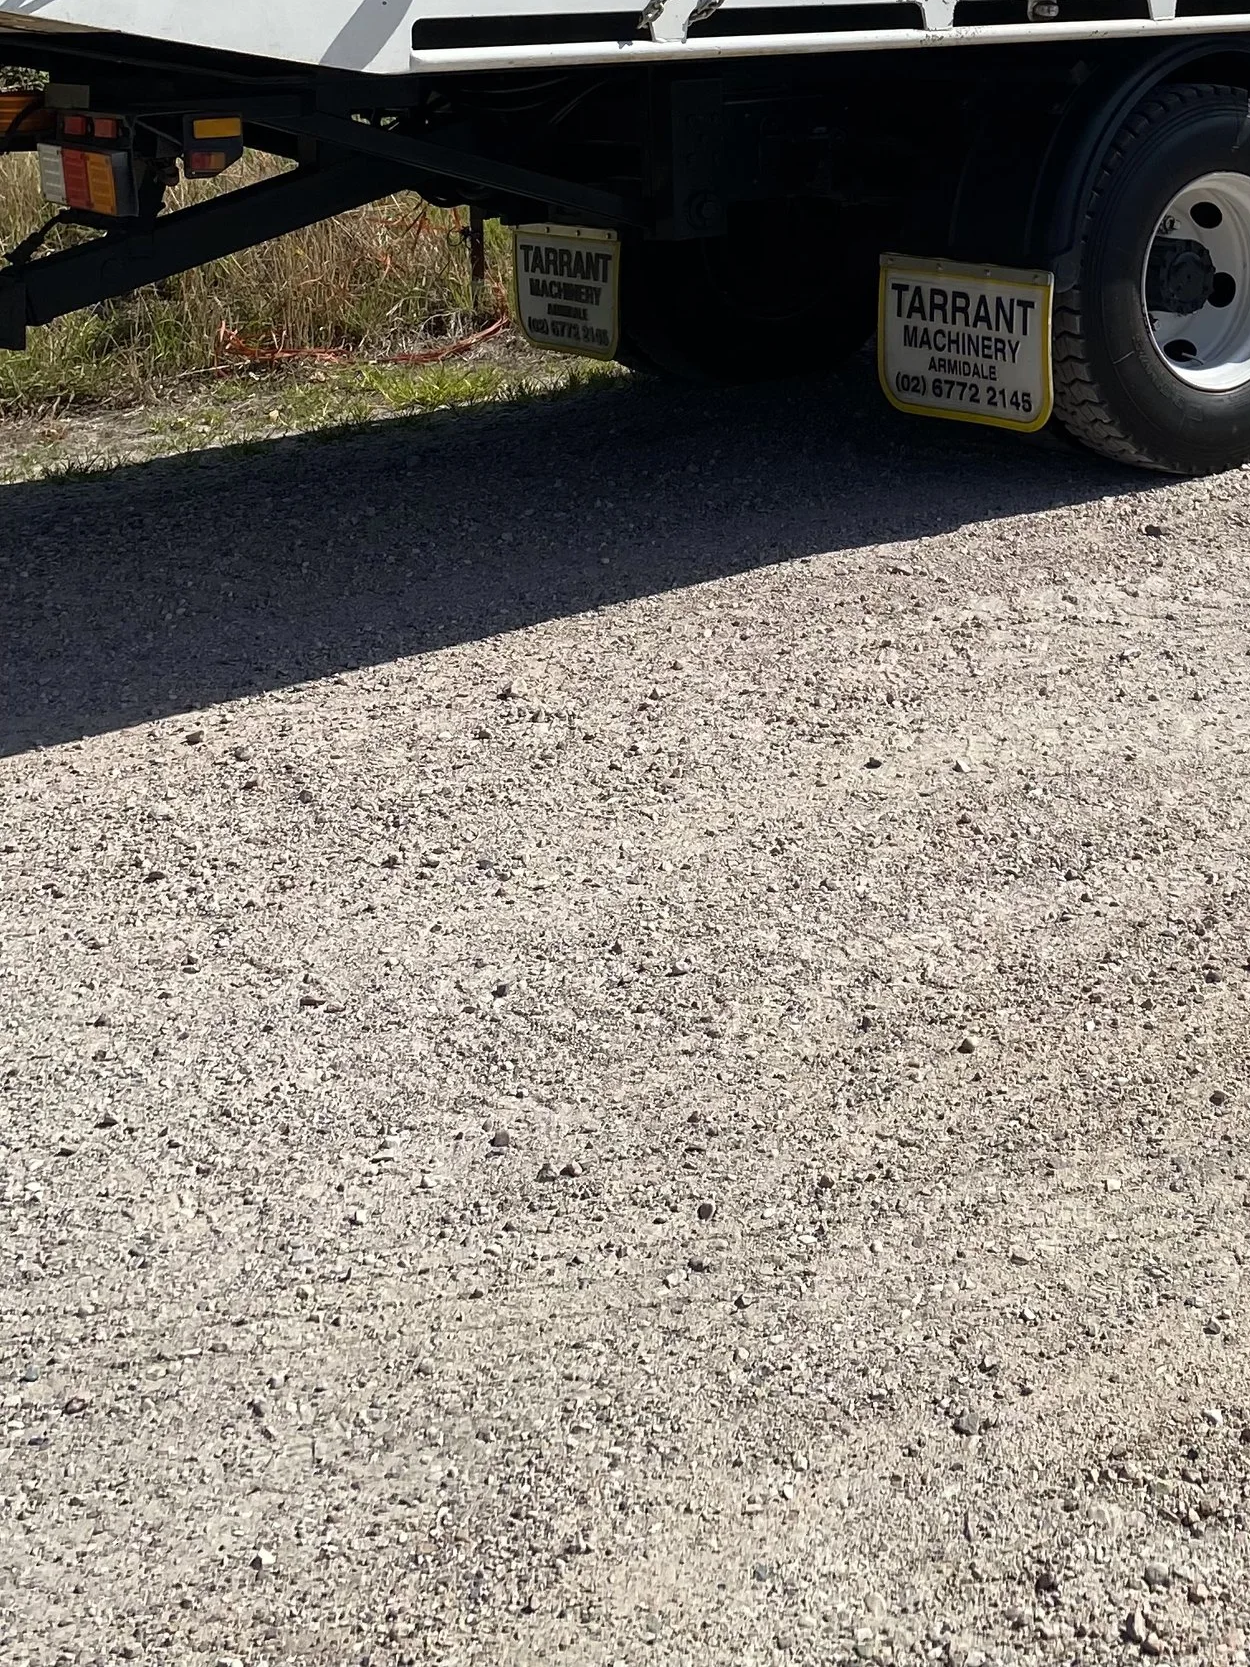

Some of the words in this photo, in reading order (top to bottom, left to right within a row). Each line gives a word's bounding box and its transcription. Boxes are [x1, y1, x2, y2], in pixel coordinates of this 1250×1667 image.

[519, 244, 612, 283] TARRANT
[891, 282, 1036, 336] TARRANT
[903, 324, 1021, 364] MACHINERY
[927, 356, 997, 381] ARMIDALE
[895, 371, 927, 396] (02)
[931, 378, 982, 404] 6772
[985, 386, 1033, 413] 2145
